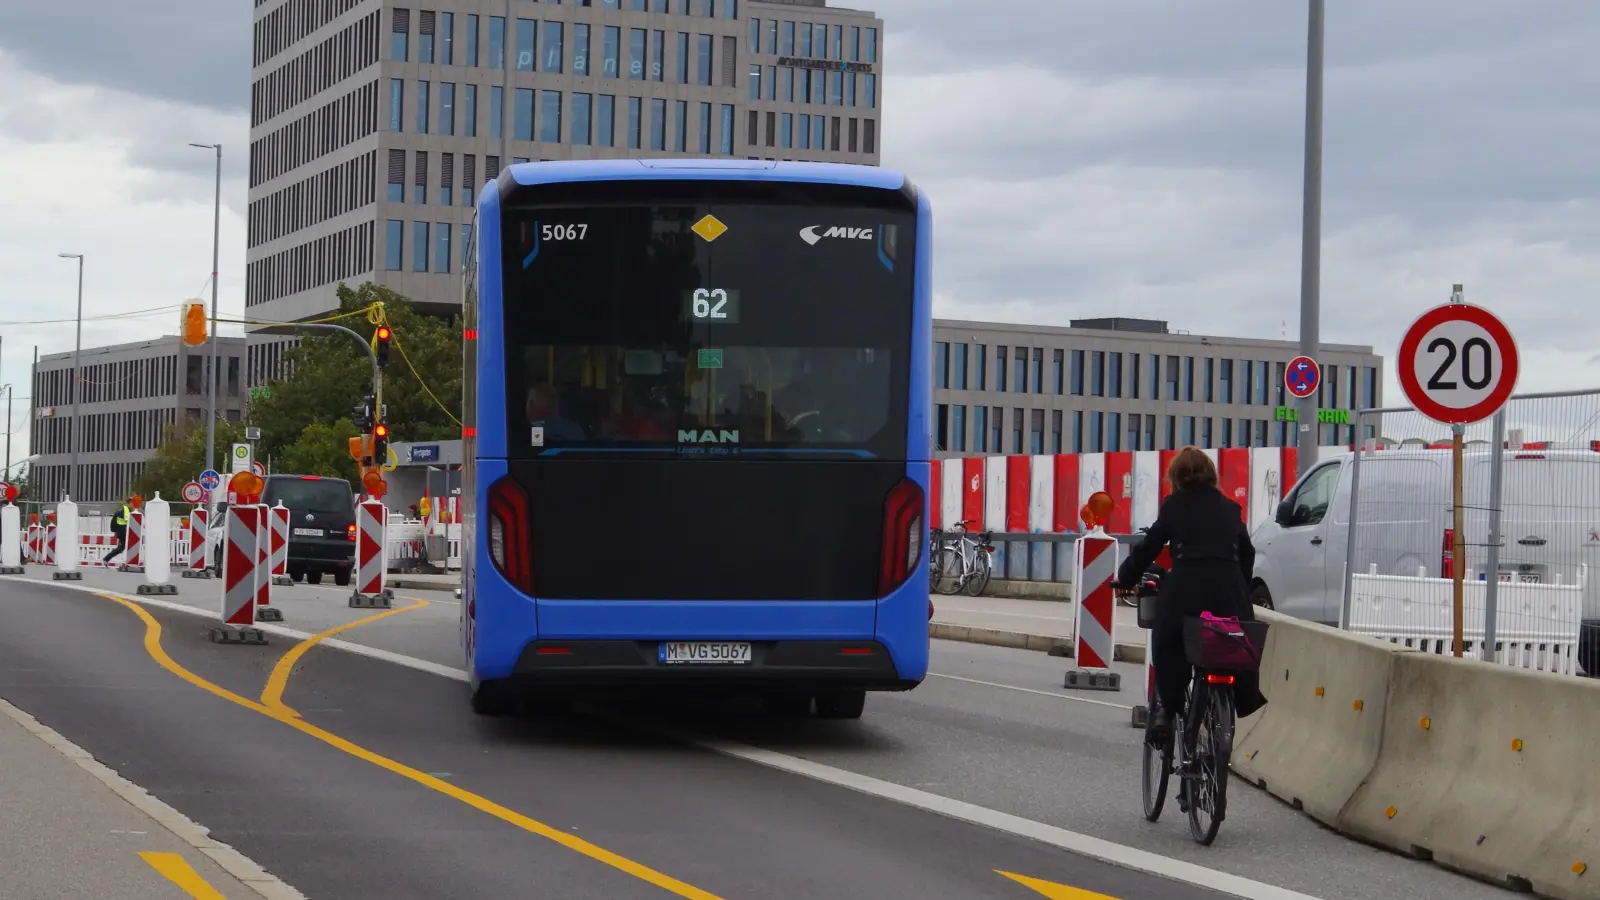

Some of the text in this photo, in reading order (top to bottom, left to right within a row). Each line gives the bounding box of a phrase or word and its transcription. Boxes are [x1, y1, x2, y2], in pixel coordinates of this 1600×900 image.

[542, 224, 588, 240] 5067
[822, 226, 873, 240] MVG
[693, 288, 727, 318] 62
[1427, 337, 1492, 390] 20
[678, 429, 739, 443] MAN
[667, 643, 678, 659] M
